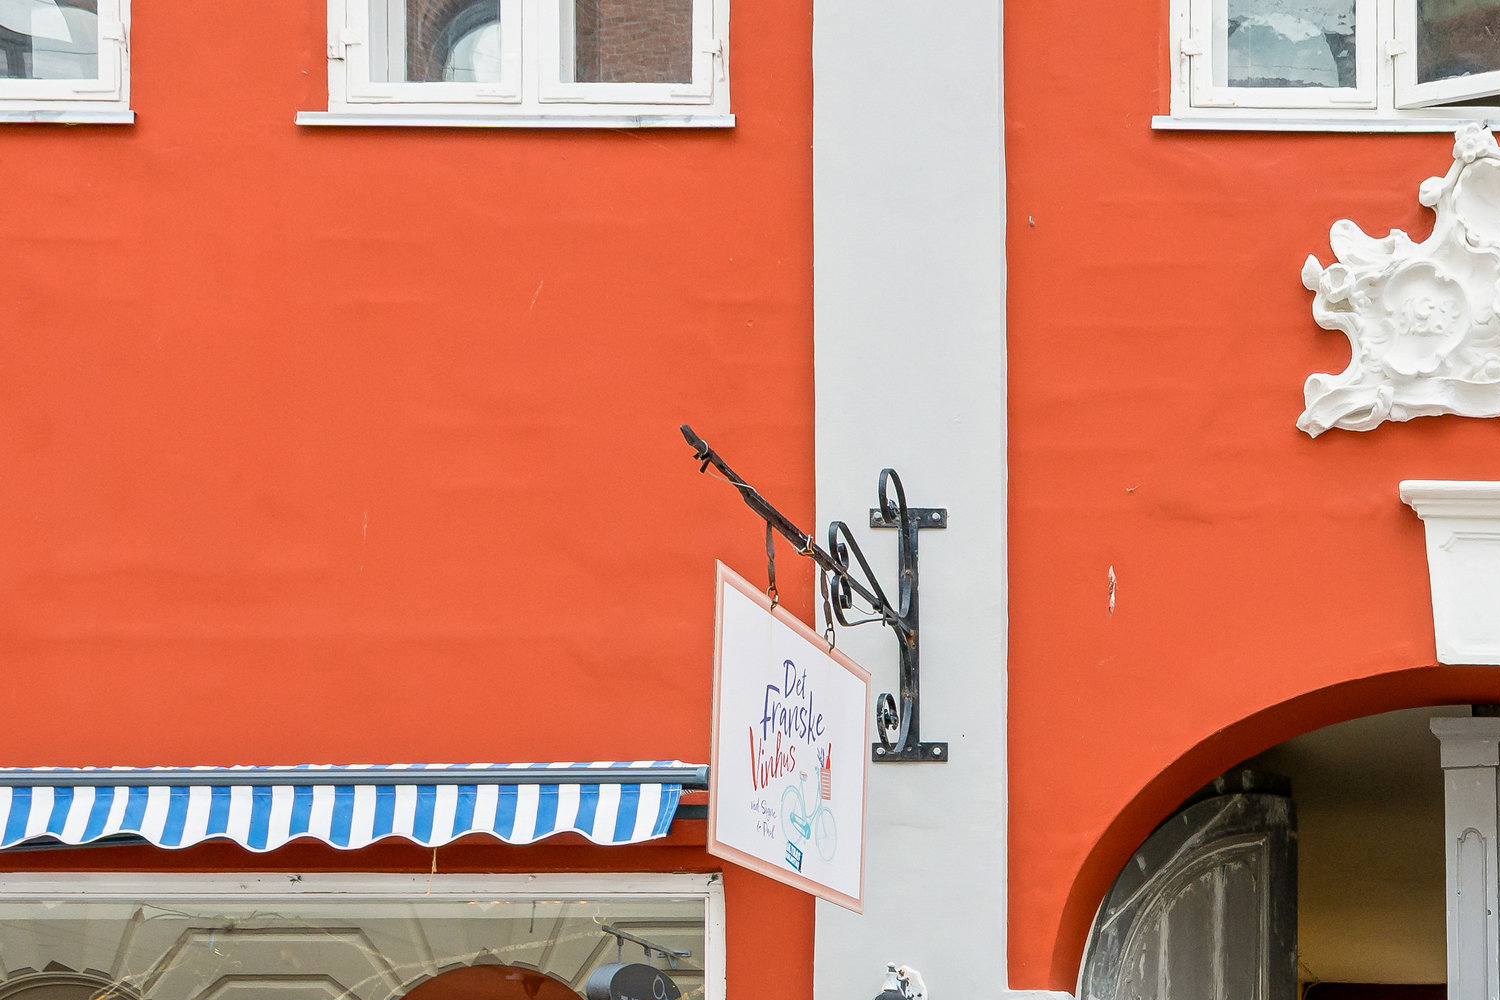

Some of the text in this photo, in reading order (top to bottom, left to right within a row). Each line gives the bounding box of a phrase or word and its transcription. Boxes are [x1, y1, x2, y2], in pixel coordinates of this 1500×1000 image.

[783, 659, 808, 700] Det
[760, 684, 826, 746] Franske
[748, 726, 797, 792] Vinhus
